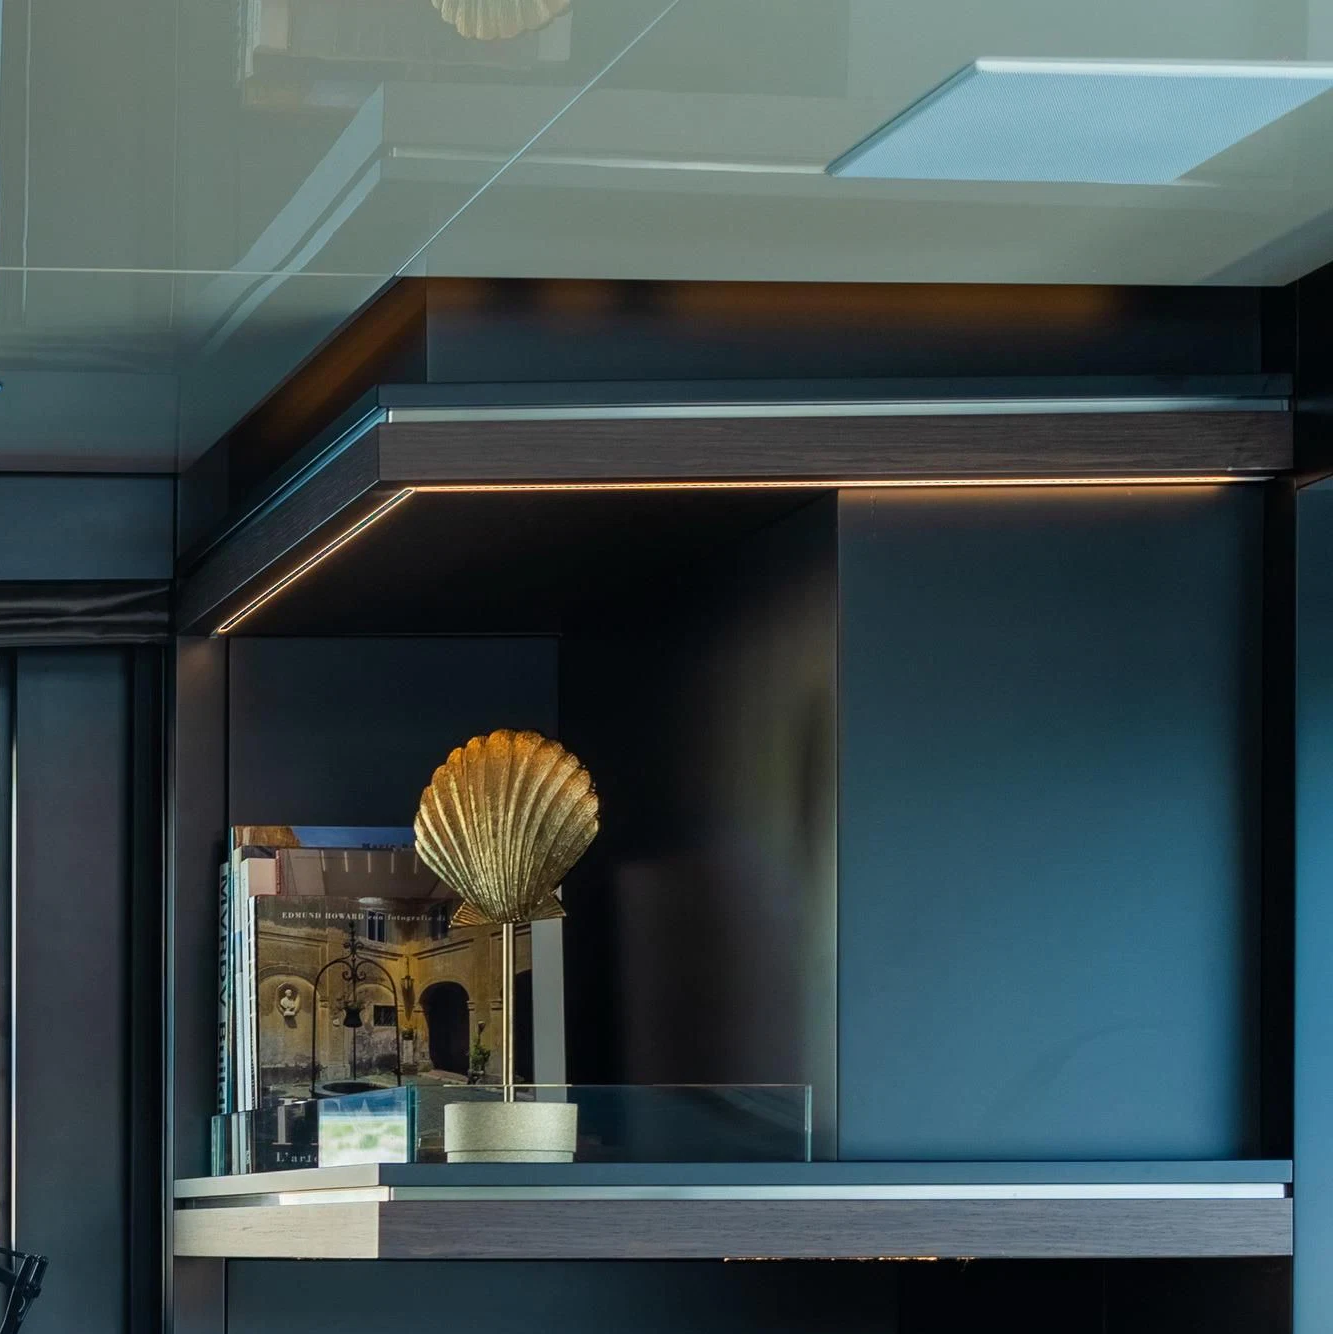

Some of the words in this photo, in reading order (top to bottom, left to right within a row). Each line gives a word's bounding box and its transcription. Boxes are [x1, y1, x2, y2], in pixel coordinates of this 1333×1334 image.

[220, 874, 228, 1008] MVRDV
[281, 911, 322, 919] EDMUND
[325, 912, 365, 920] HOWARD
[387, 913, 433, 922] fotografie
